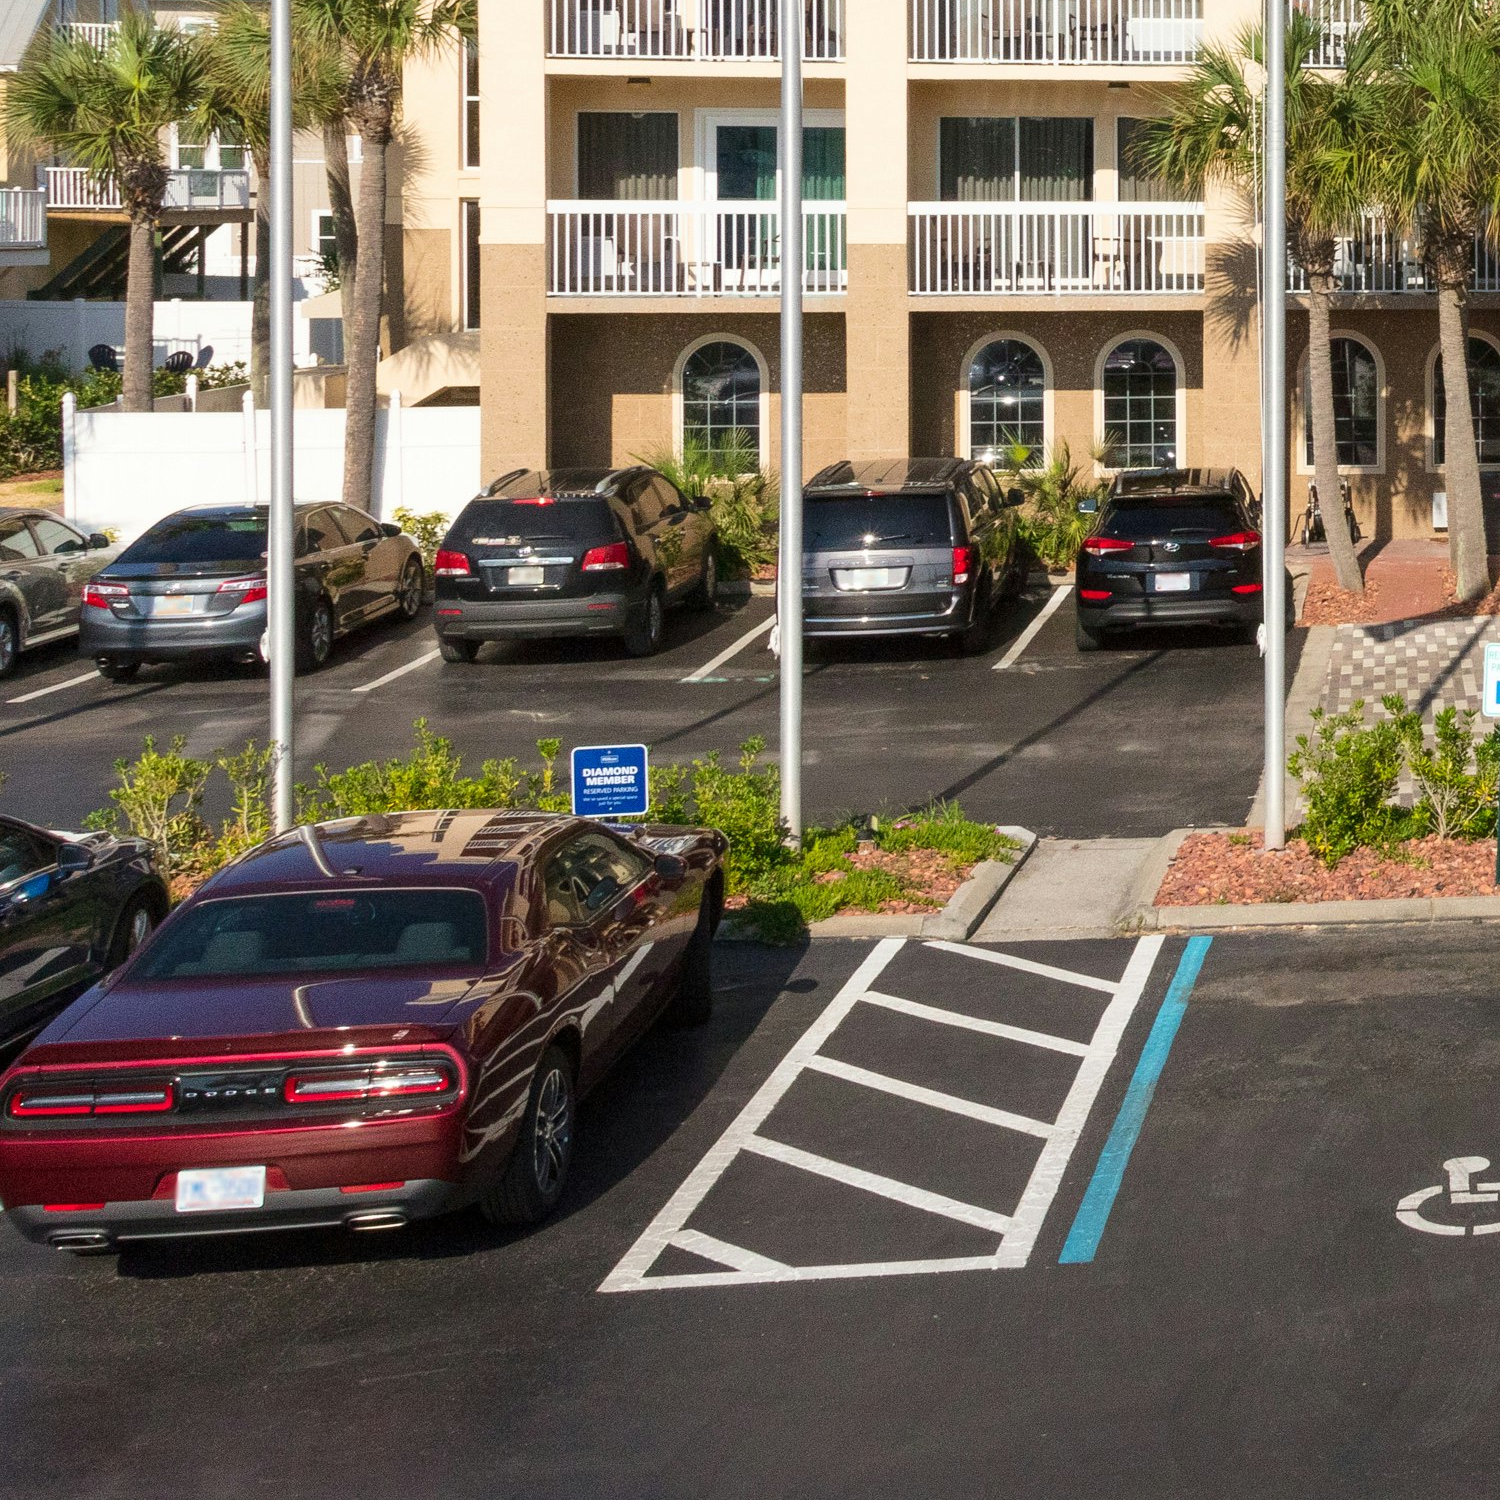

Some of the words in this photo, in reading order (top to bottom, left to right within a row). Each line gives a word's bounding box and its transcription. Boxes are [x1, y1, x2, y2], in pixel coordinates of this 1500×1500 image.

[582, 766, 638, 777] DIAMOND
[586, 775, 635, 786] MEMBER
[185, 1087, 276, 1098] DODGE
